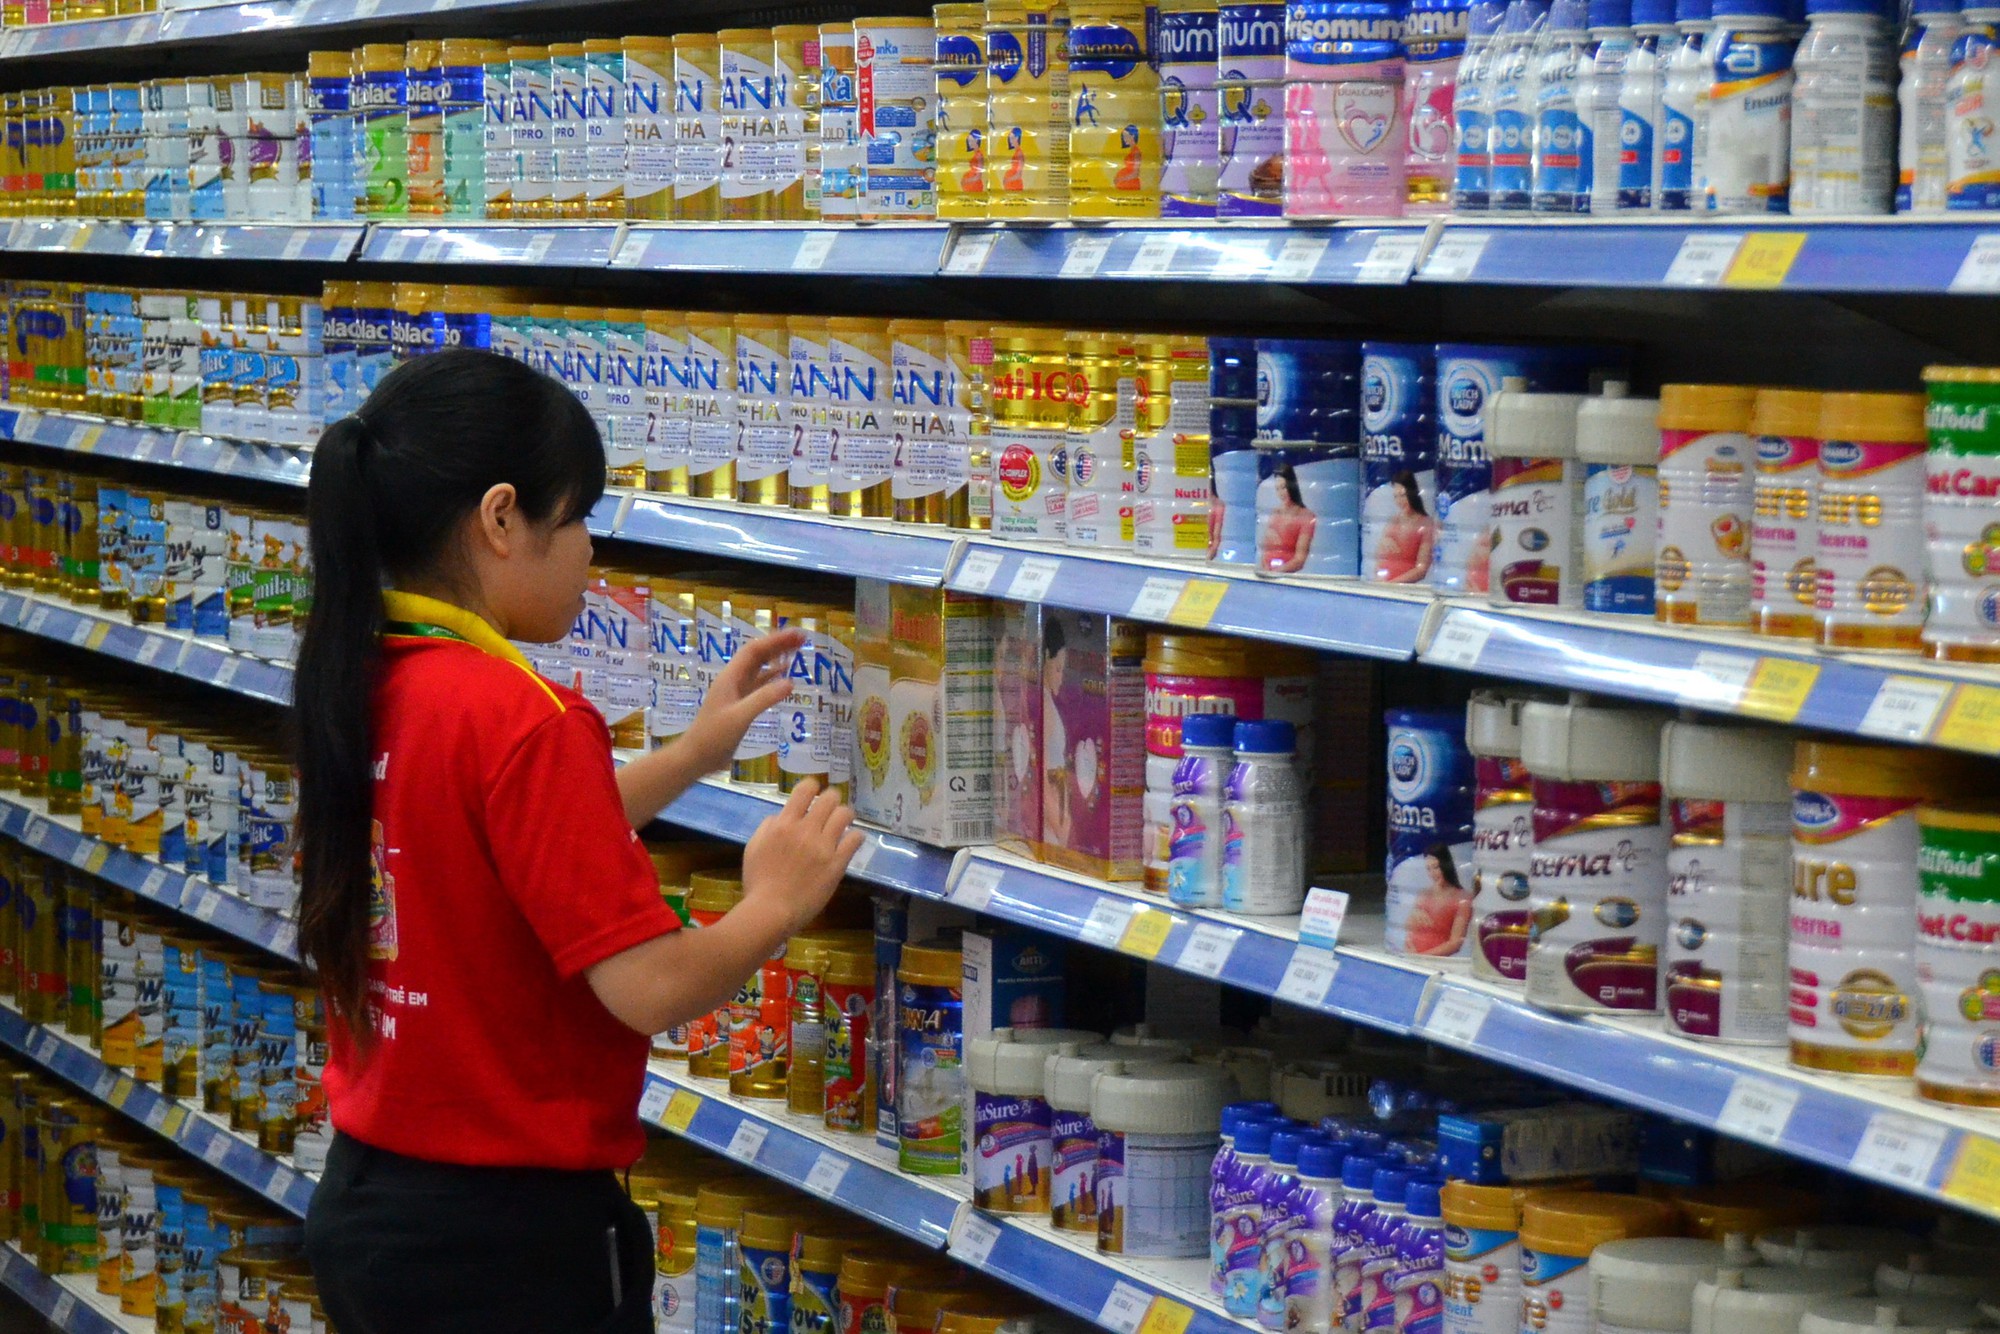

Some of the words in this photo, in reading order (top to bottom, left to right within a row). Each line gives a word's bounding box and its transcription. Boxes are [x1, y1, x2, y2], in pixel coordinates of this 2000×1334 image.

[634, 122, 663, 140] HA
[723, 136, 734, 168] 2
[846, 411, 880, 431] HA
[911, 415, 946, 436] HA
[792, 424, 804, 457] 2
[830, 428, 840, 462] 2
[894, 432, 904, 467] 2
[1438, 432, 1494, 461] Mam
[1174, 487, 1203, 499] Nuti
[208, 509, 218, 526] 3
[791, 710, 807, 744] 3
[214, 753, 224, 771] 3
[408, 991, 428, 1006] EM
